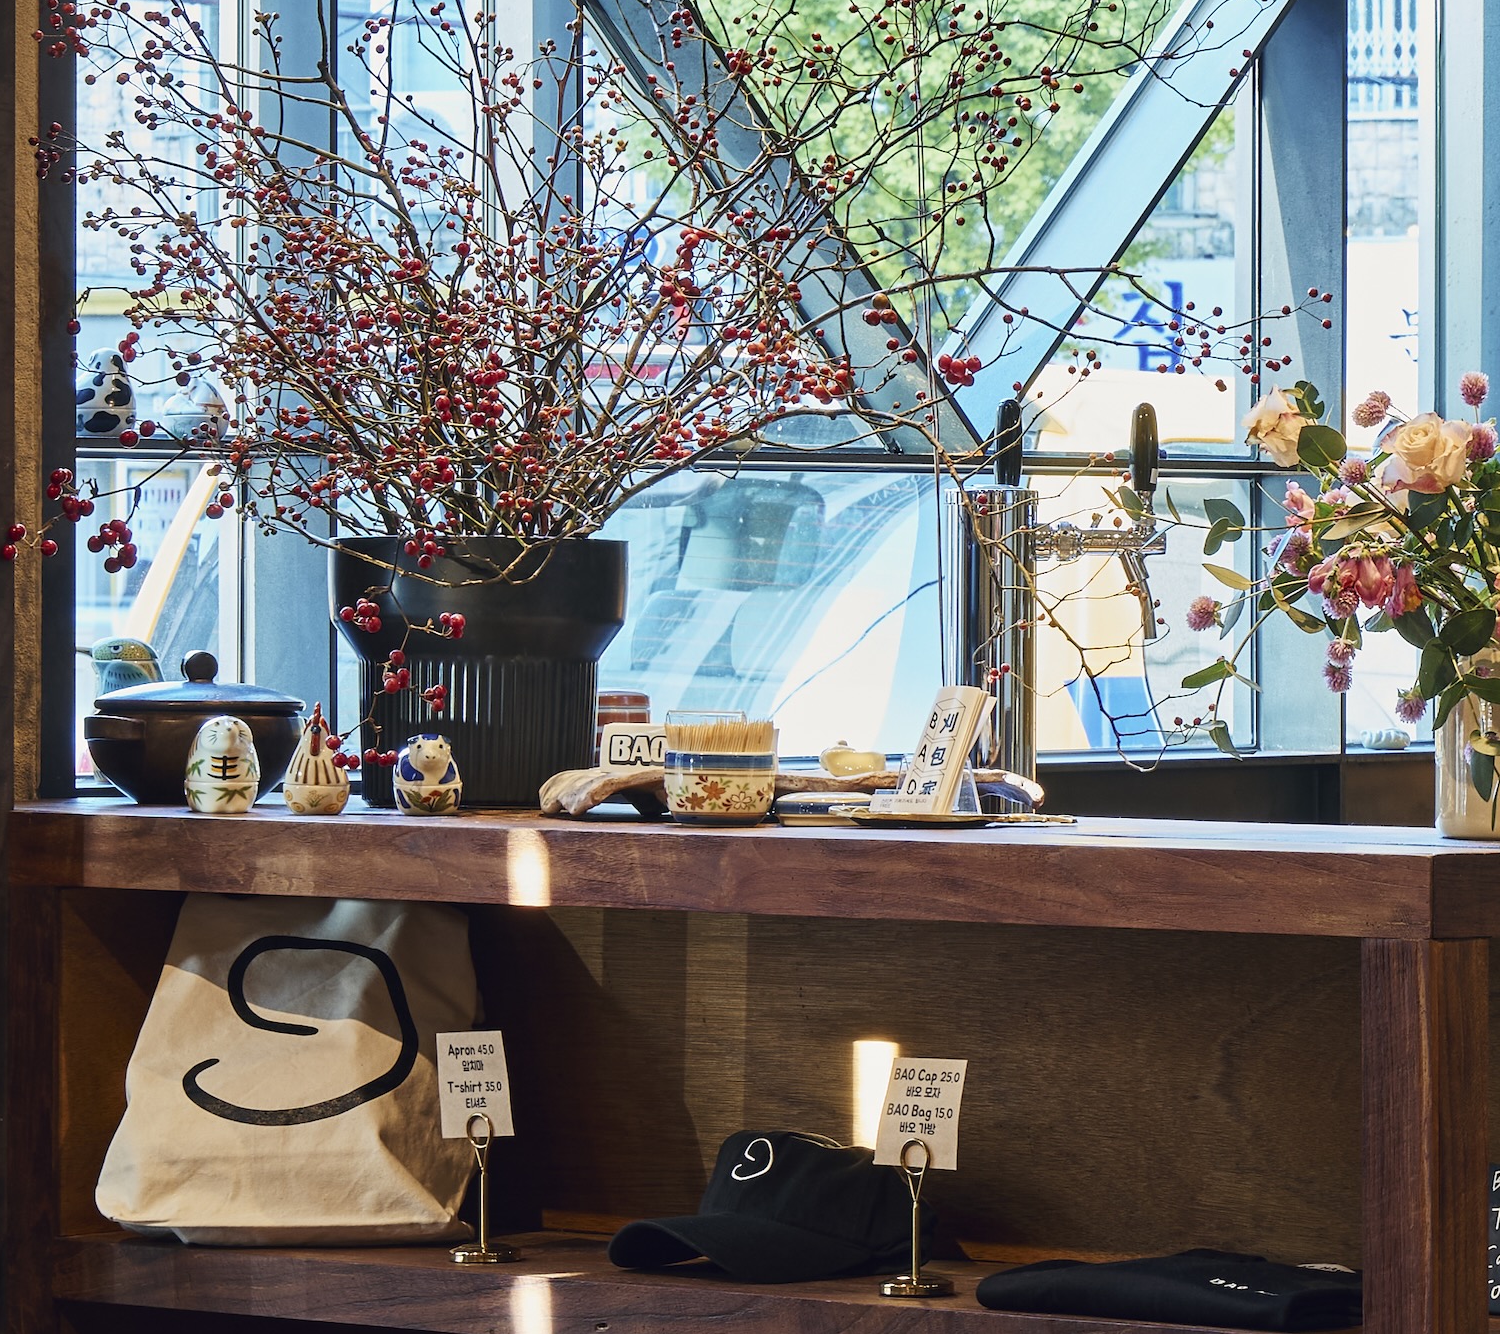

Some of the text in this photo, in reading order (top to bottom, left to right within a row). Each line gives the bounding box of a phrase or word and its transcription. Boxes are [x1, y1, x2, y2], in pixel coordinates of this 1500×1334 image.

[448, 1044, 495, 1059] Apron 45.0
[462, 1060, 484, 1072] 앞치마
[894, 1068, 961, 1085] BAO Cap 25.0
[447, 1081, 502, 1093] T-shirt 35.0
[906, 1086, 941, 1098] 바오 모자
[465, 1097, 487, 1109] 티셔츠
[886, 1103, 954, 1121] BAO Bag 15.0
[899, 1122, 936, 1135] 바오 가방
